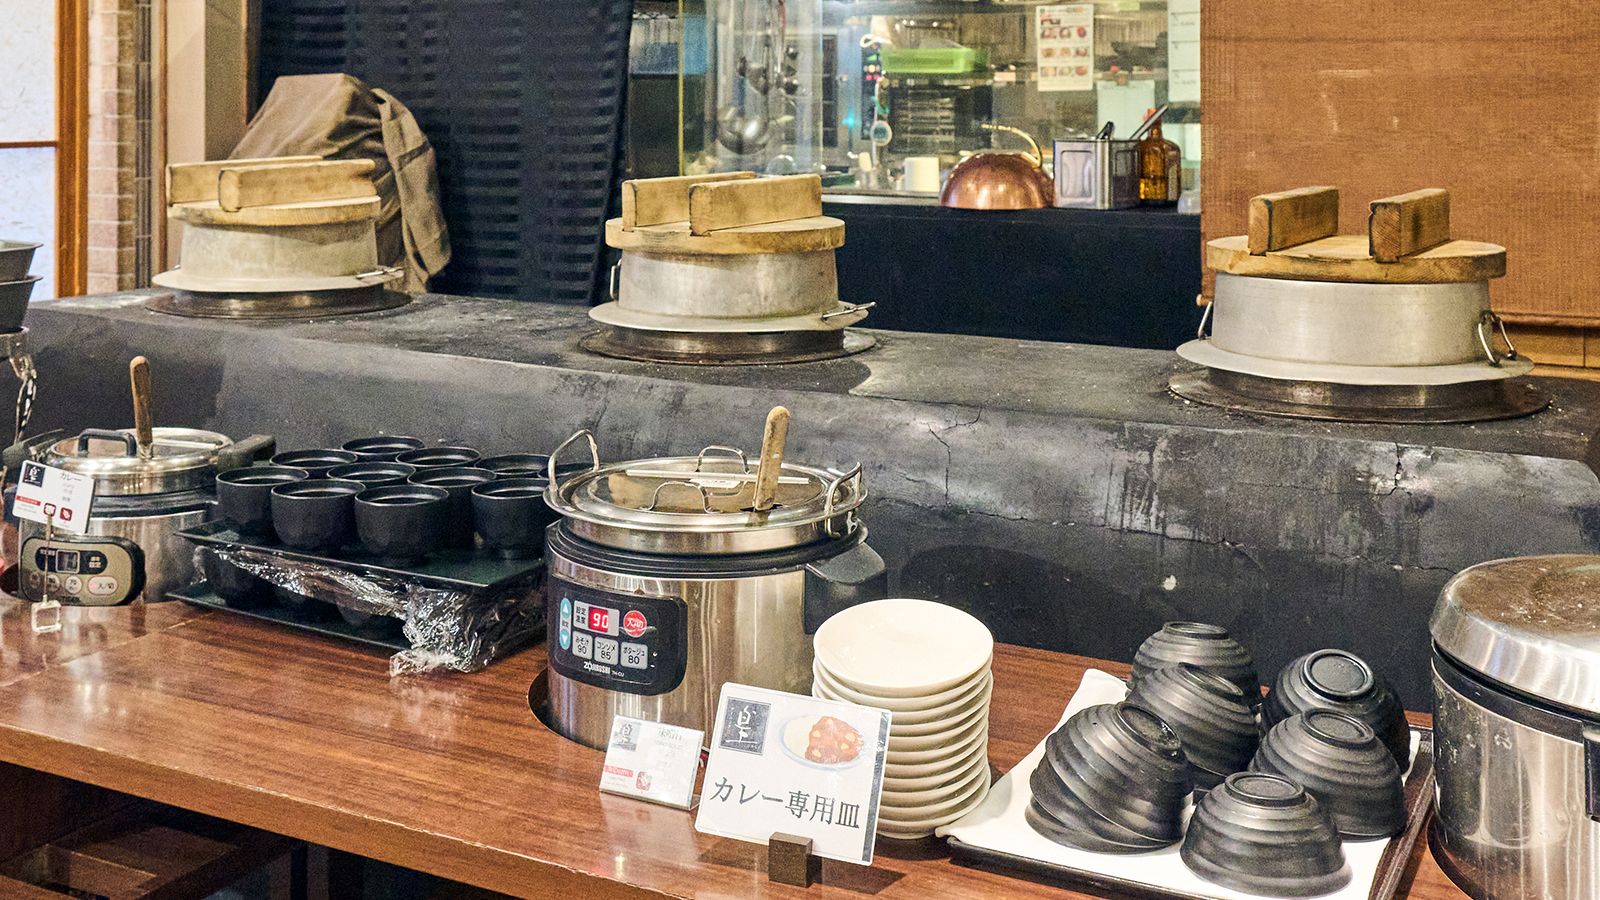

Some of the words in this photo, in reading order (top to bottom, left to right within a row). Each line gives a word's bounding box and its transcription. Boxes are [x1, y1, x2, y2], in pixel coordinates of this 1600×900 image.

[60, 472, 81, 482] カレー
[593, 612, 609, 628] 90
[577, 645, 587, 654] 90
[600, 651, 611, 660] 85
[628, 656, 640, 664] 80
[709, 776, 861, 829] カレー専用皿
